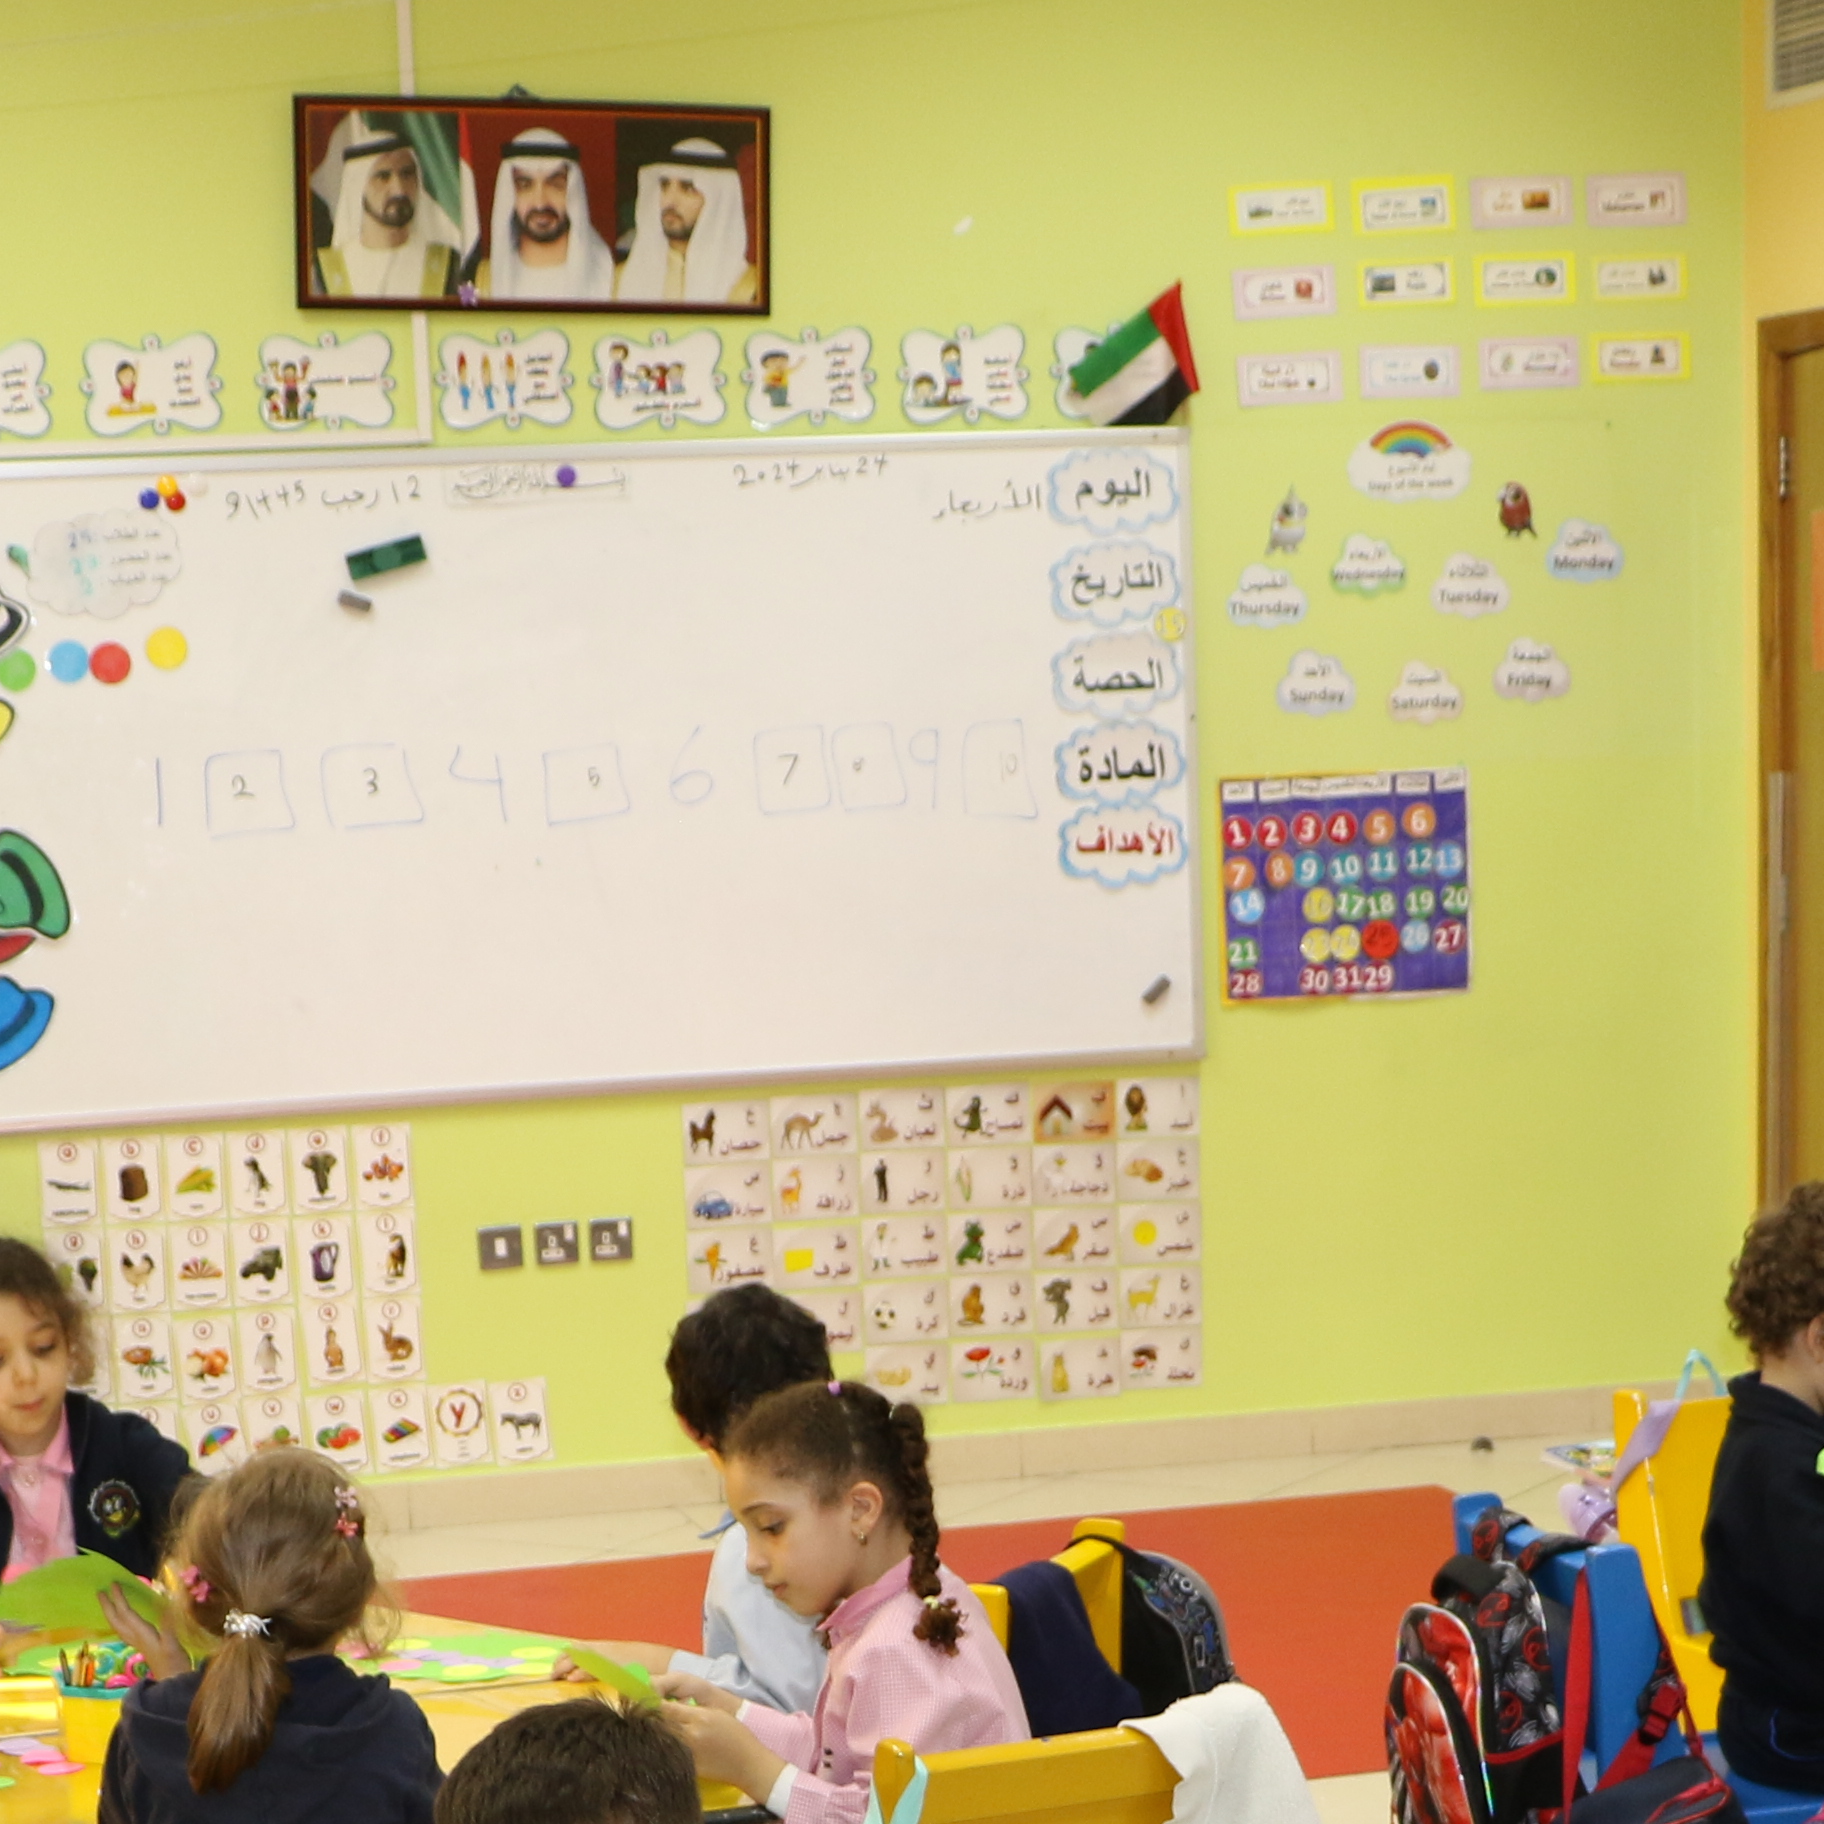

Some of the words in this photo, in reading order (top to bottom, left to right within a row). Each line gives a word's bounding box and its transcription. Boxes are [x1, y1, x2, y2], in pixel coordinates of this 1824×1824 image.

[856, 453, 888, 475] 24
[1075, 468, 1151, 507] اليوم
[1332, 565, 1405, 582] Wednesday
[1553, 555, 1614, 572] Monday
[1070, 561, 1163, 605] التاريخ
[1439, 588, 1499, 606] Tuesday
[1229, 600, 1300, 617] Thursday
[1072, 655, 1164, 693] الحصة
[1507, 672, 1552, 690] Friday
[1289, 687, 1345, 704] Sunday
[1392, 694, 1457, 711] Saturday
[155, 757, 163, 827] 1
[231, 774, 255, 798] 2
[363, 766, 379, 795] 3
[449, 744, 508, 824] 4
[588, 765, 601, 788] 5
[670, 724, 715, 806] 6
[778, 752, 799, 786] 7
[909, 727, 940, 811] 9
[1078, 743, 1165, 783] المادة
[1076, 822, 1175, 858] الأهداف
[1229, 822, 1245, 844] 1
[1263, 820, 1280, 844] 2
[1299, 816, 1316, 838] 3
[1331, 815, 1348, 838] 4
[1372, 816, 1387, 837] 5
[1411, 809, 1427, 831] 6
[1231, 864, 1246, 886] 7
[1271, 857, 1286, 879] 8
[1301, 859, 1317, 880] 9
[1332, 855, 1359, 877] 10
[1369, 853, 1395, 873] 11
[1408, 848, 1433, 869] 12
[1436, 848, 1462, 869] 13
[1339, 892, 1366, 914] 17
[1367, 893, 1394, 916] 18
[1406, 891, 1434, 912] 19
[1442, 886, 1470, 908] 20
[1230, 942, 1257, 963] 21
[1436, 925, 1463, 947] 27
[1232, 972, 1260, 995] 28
[1301, 969, 1328, 991] 30
[1334, 966, 1362, 988] 31
[1364, 965, 1392, 987] 29
